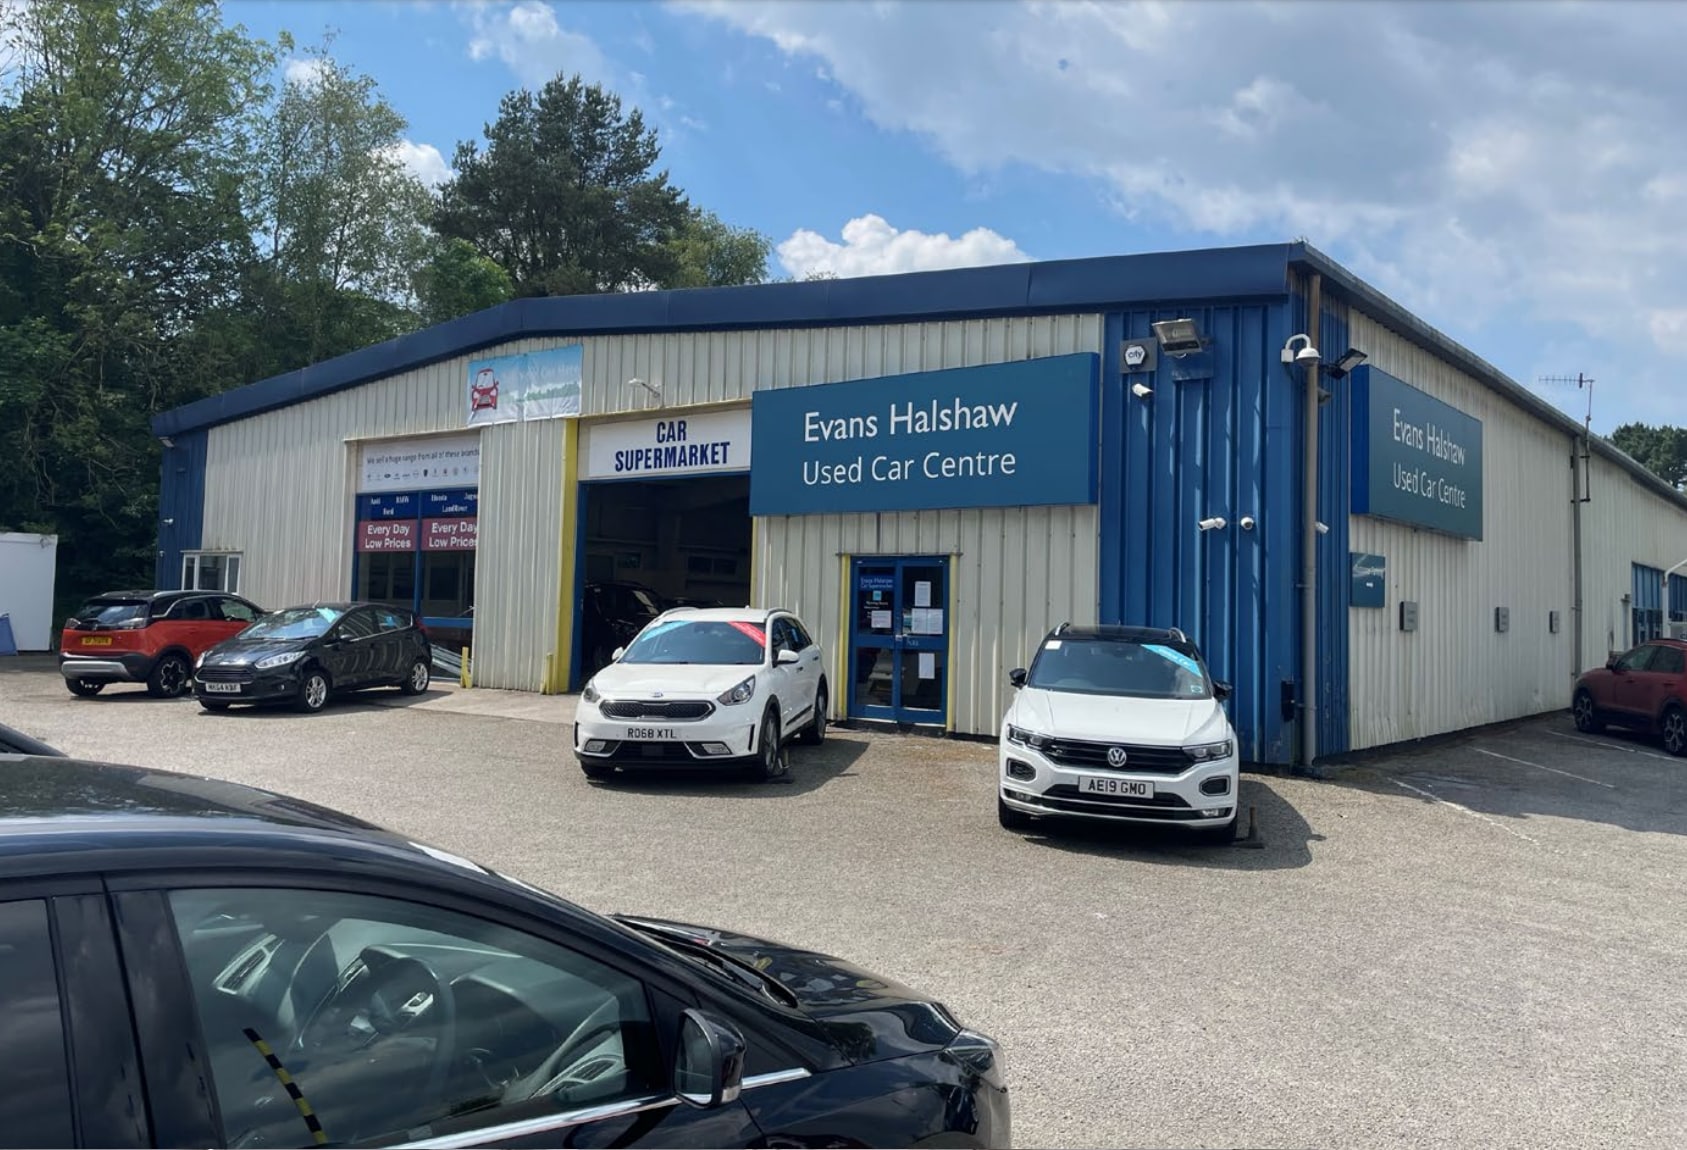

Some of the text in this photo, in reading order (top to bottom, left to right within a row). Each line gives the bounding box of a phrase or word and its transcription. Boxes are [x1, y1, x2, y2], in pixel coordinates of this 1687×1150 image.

[804, 397, 1018, 442] Evans Halshaw
[656, 420, 687, 443] CAR
[1393, 407, 1466, 466] Evans Halshaw
[402, 454, 417, 463] range
[418, 452, 430, 460] from
[445, 450, 460, 458] these
[615, 441, 731, 472] SUPERMARKET
[803, 451, 1016, 485] Used Car Centre
[1393, 462, 1466, 509] Used Car Centre
[367, 524, 410, 537] Every Day
[431, 522, 457, 534] Every
[365, 538, 411, 549] Low Prices
[429, 537, 448, 547] Low
[657, 728, 677, 739] XTL
[1088, 779, 1146, 795] AE19 GMO
